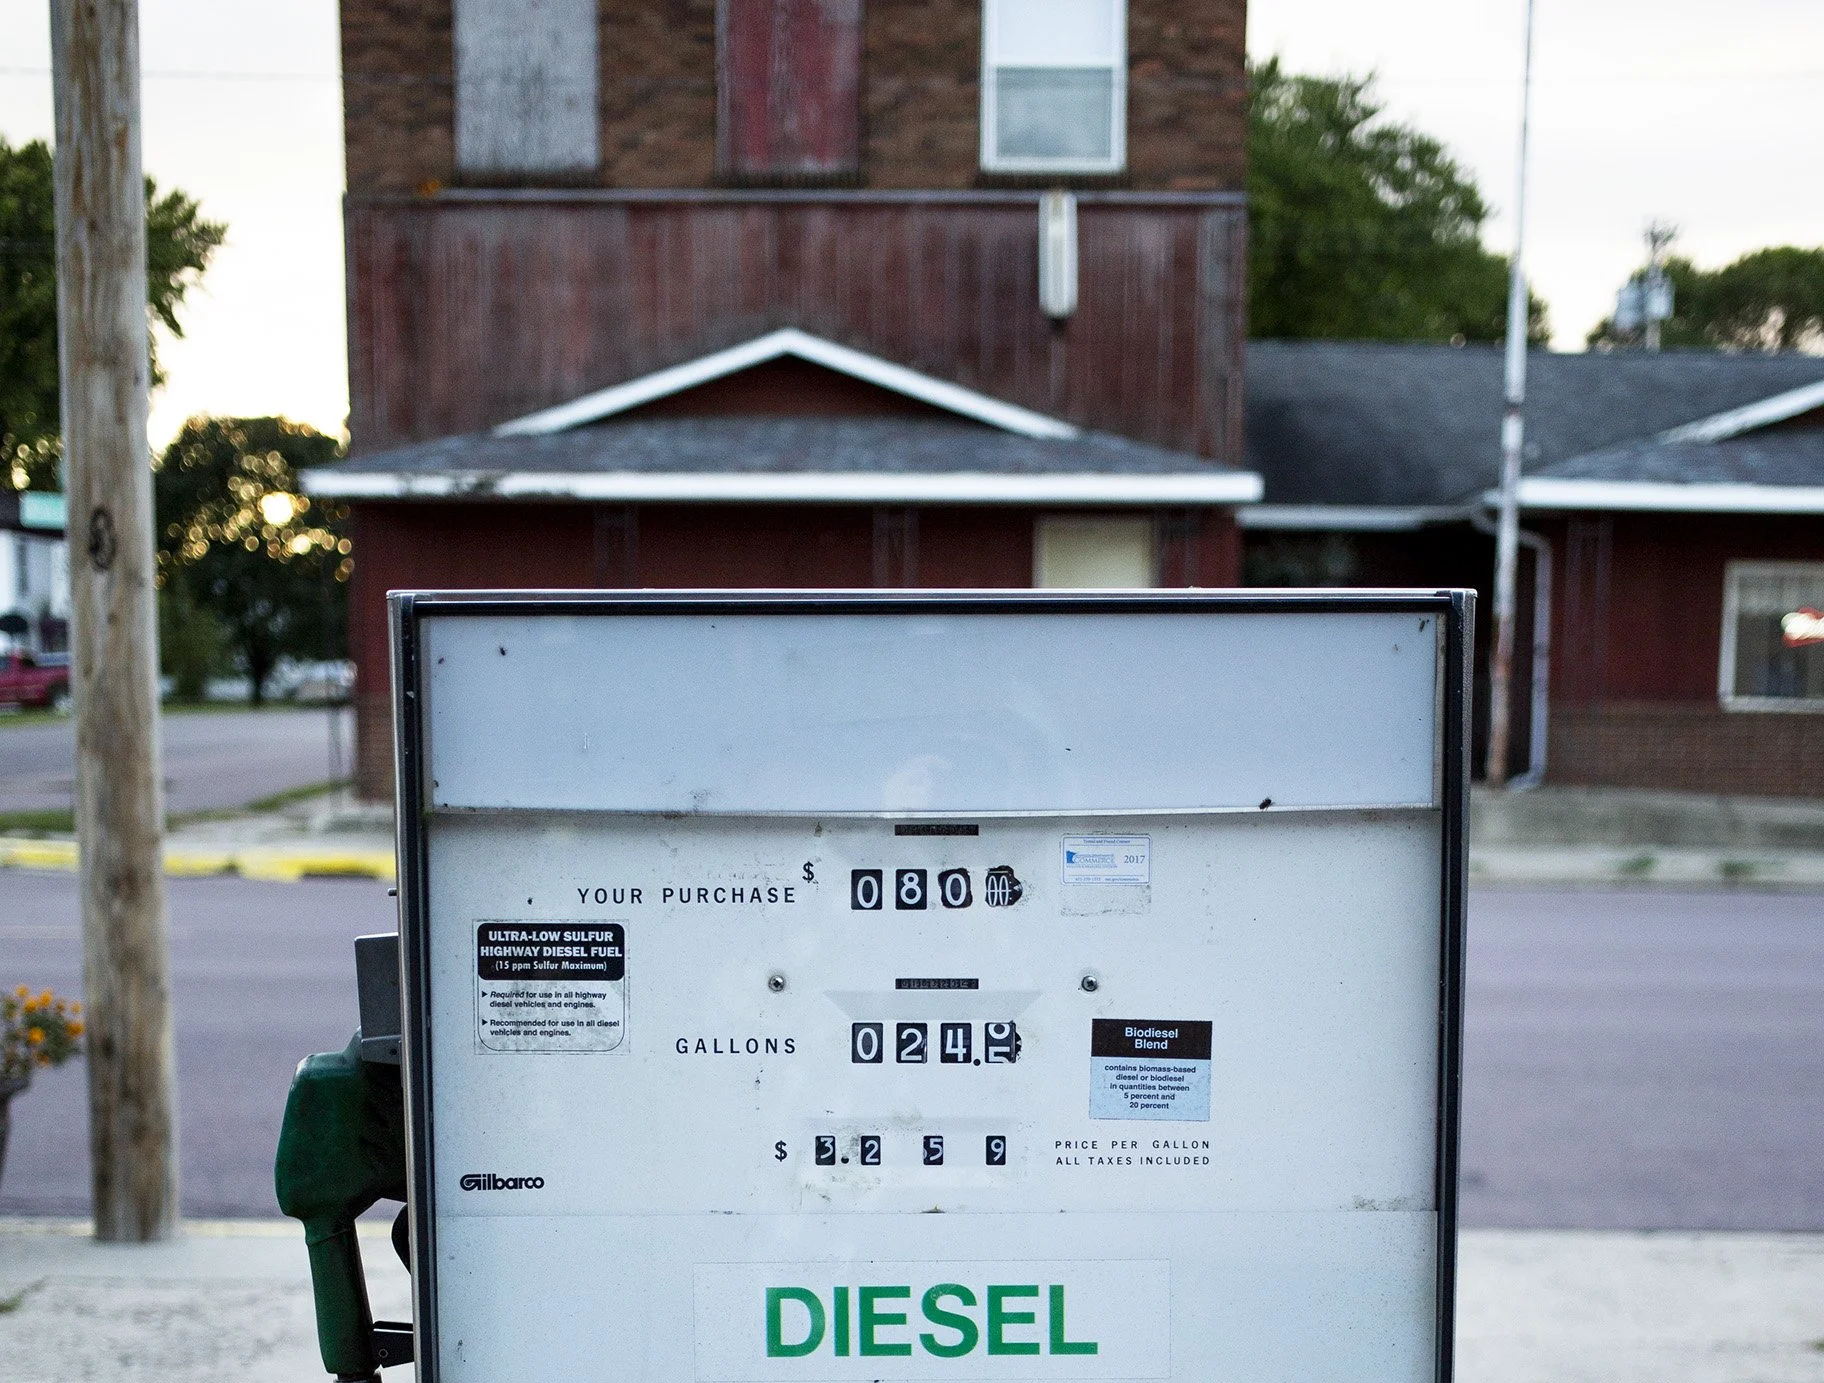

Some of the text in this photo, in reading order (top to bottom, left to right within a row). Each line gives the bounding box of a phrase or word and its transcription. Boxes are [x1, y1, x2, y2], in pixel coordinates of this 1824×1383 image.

[1123, 855, 1146, 864] 2017
[577, 887, 796, 905] YOUR PURCHASE
[488, 931, 613, 942] ULTRA-LOW SULFUR
[480, 946, 622, 957] HIGHWAY DIESEL FUEL
[495, 960, 608, 972] (15 ppm Sulfur Maximum)
[489, 991, 525, 1000] Required
[575, 991, 607, 1000] highway
[489, 1000, 596, 1009] diesel vehicles and engines.
[539, 1029, 571, 1038] engines.
[1124, 1027, 1179, 1039] Biodiesel
[675, 1038, 797, 1054] GALLONS
[1134, 1039, 1168, 1050] Blend
[1104, 1064, 1197, 1073] contains biomass-based
[1116, 1073, 1138, 1081] diesel
[1150, 1074, 1185, 1082] biodiesel
[1119, 1083, 1156, 1091] quantities
[1158, 1083, 1190, 1091] between
[1130, 1093, 1159, 1101] percent
[1140, 1102, 1169, 1110] percent
[1055, 1140, 1210, 1149] PRICE PER GALLON
[774, 1140, 788, 1162] $
[1055, 1156, 1210, 1165] ALL TAXES INCLUDED
[460, 1173, 545, 1191] Gilbarco
[765, 1283, 1099, 1358] DIESEL
